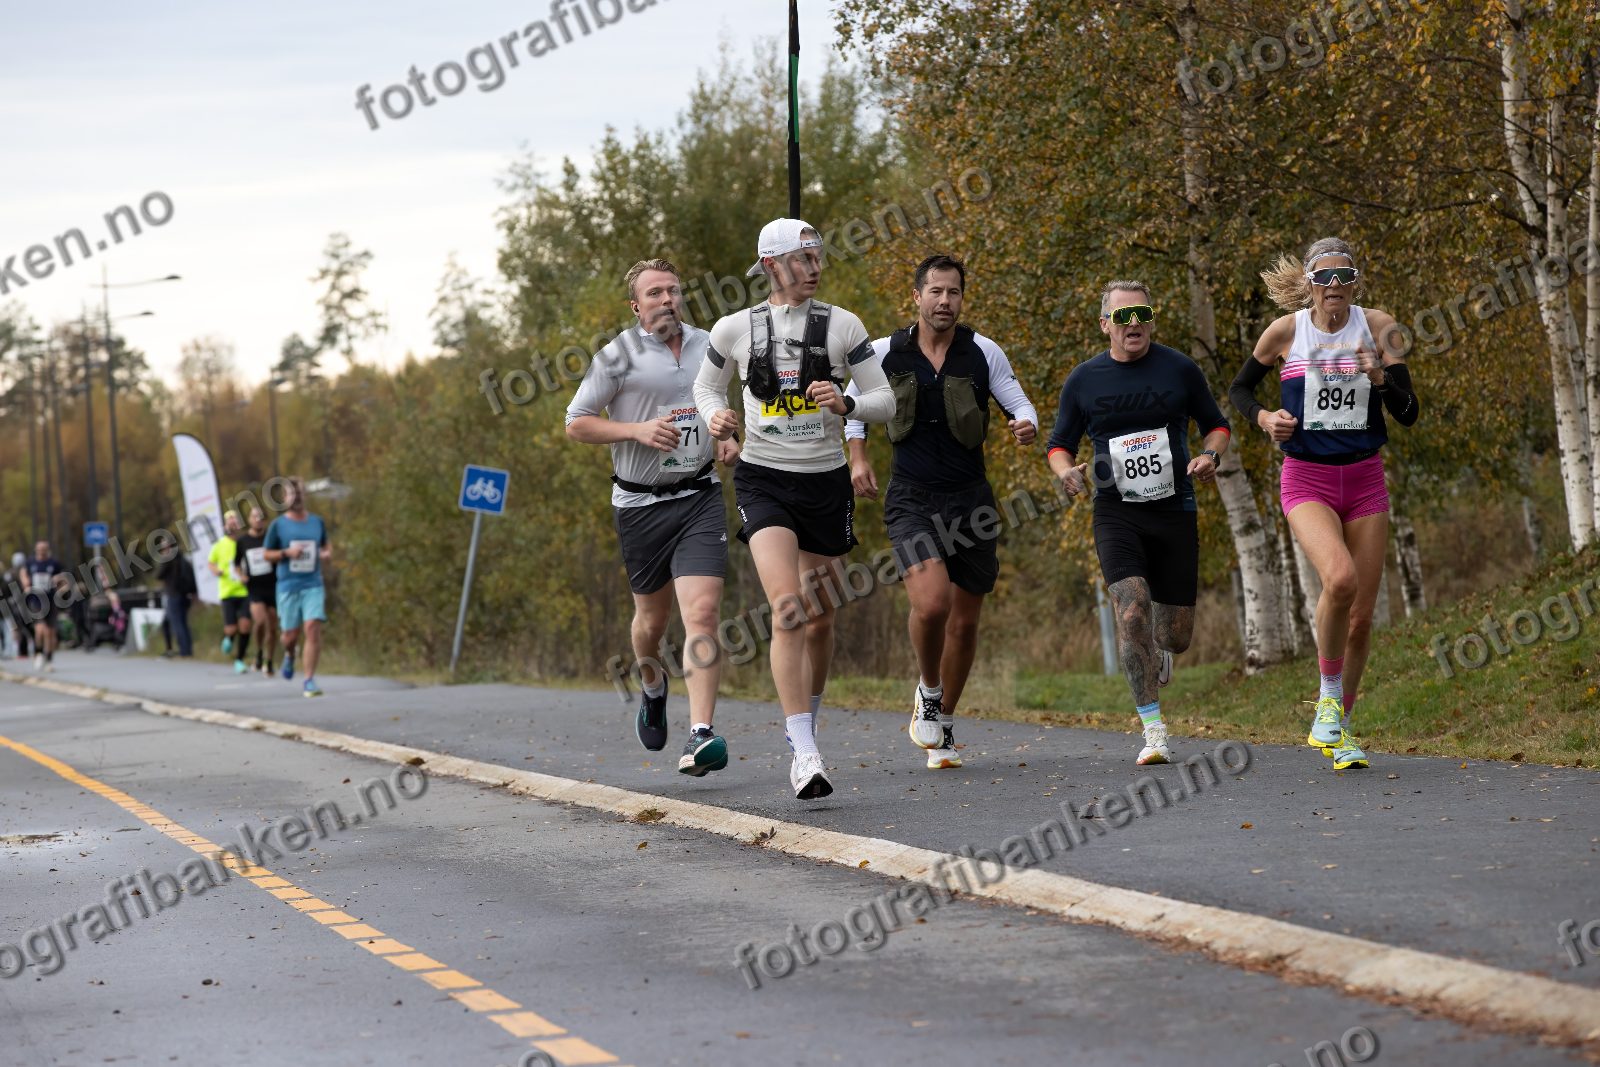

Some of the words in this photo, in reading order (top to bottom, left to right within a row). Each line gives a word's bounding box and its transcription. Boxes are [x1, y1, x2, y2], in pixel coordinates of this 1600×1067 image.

[1318, 387, 1356, 410] 894
[672, 407, 699, 415] NORGE
[786, 422, 821, 431] Aurskog
[1332, 421, 1366, 430] Aurskog
[681, 425, 699, 446] 71
[1122, 435, 1157, 447] NORGES
[1127, 442, 1152, 453] LØPET
[1125, 454, 1162, 479] 885
[1143, 482, 1173, 494] Aurskog
